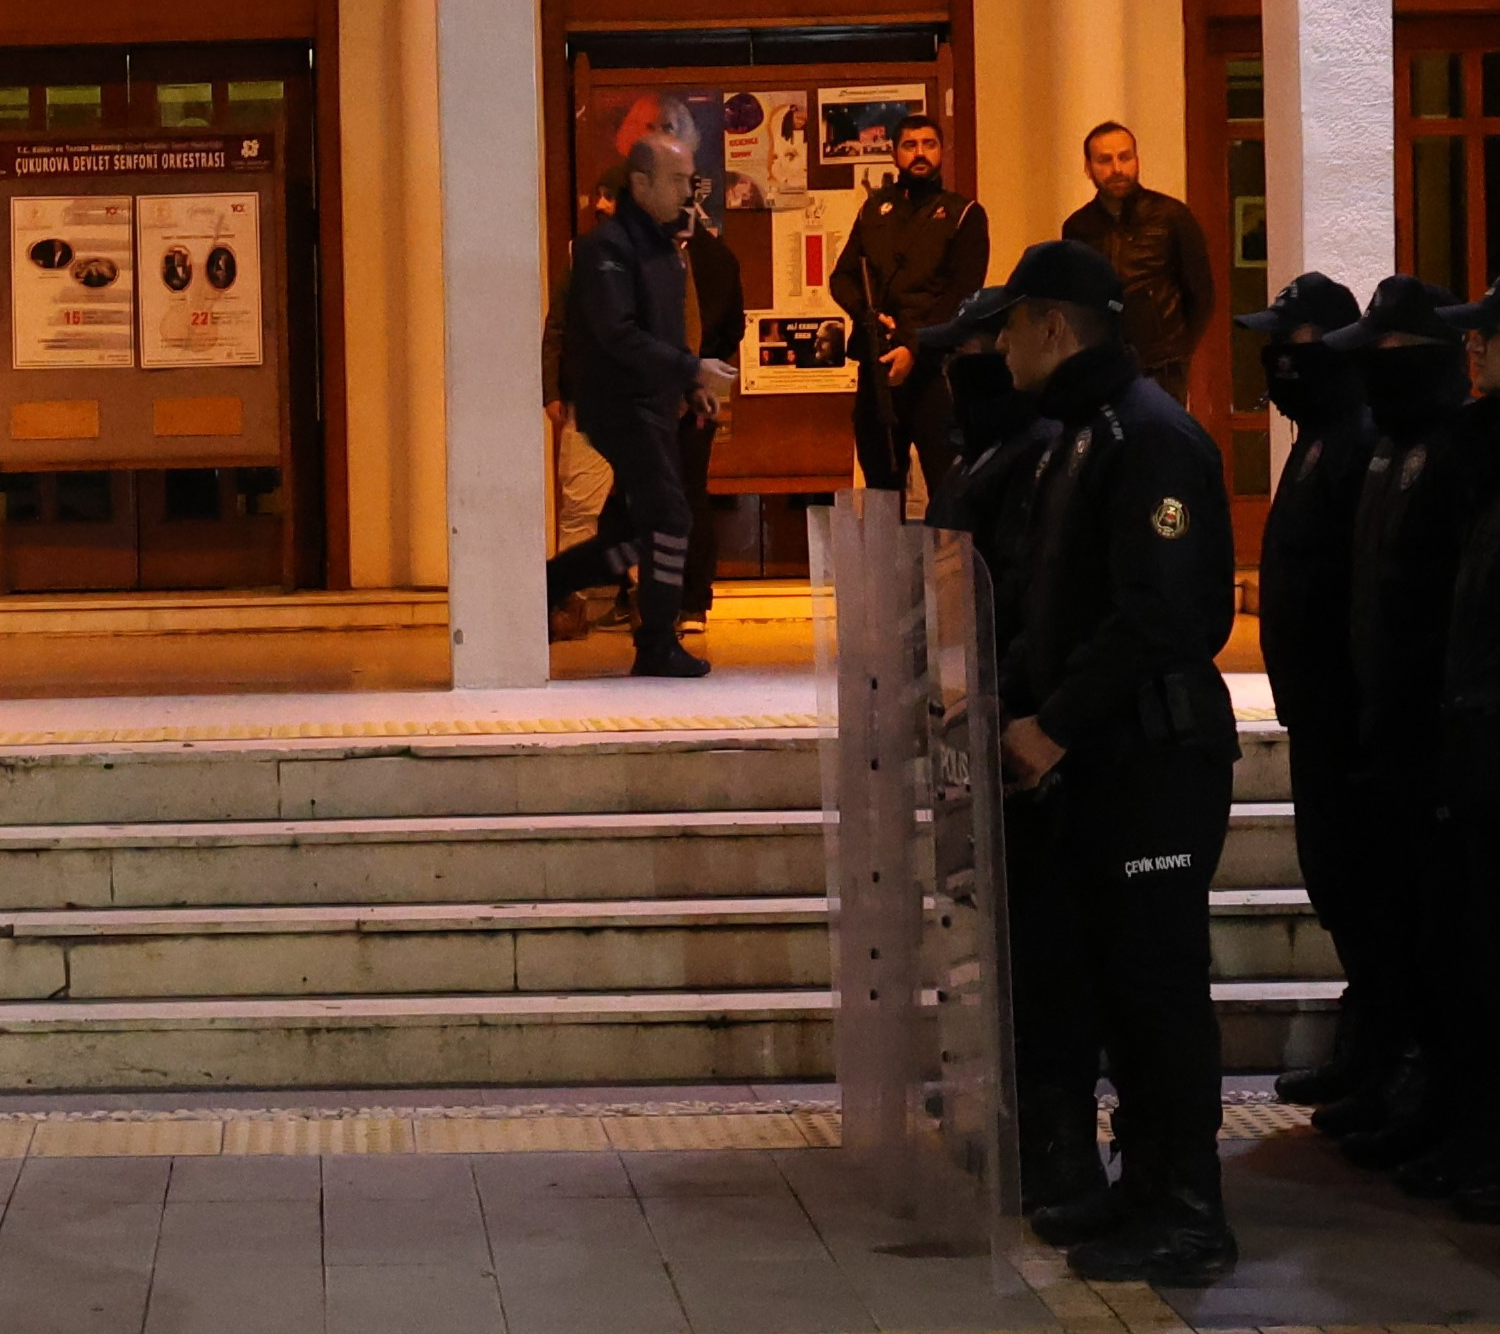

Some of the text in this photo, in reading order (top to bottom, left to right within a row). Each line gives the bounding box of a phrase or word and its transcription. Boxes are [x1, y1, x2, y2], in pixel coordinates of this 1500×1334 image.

[15, 156, 70, 177] ÇUKUROVA
[73, 154, 110, 172] DEVLET
[113, 150, 158, 171] SENFONİ
[161, 151, 225, 169] ORKESTRASI
[1154, 853, 1192, 870] KUVVET
